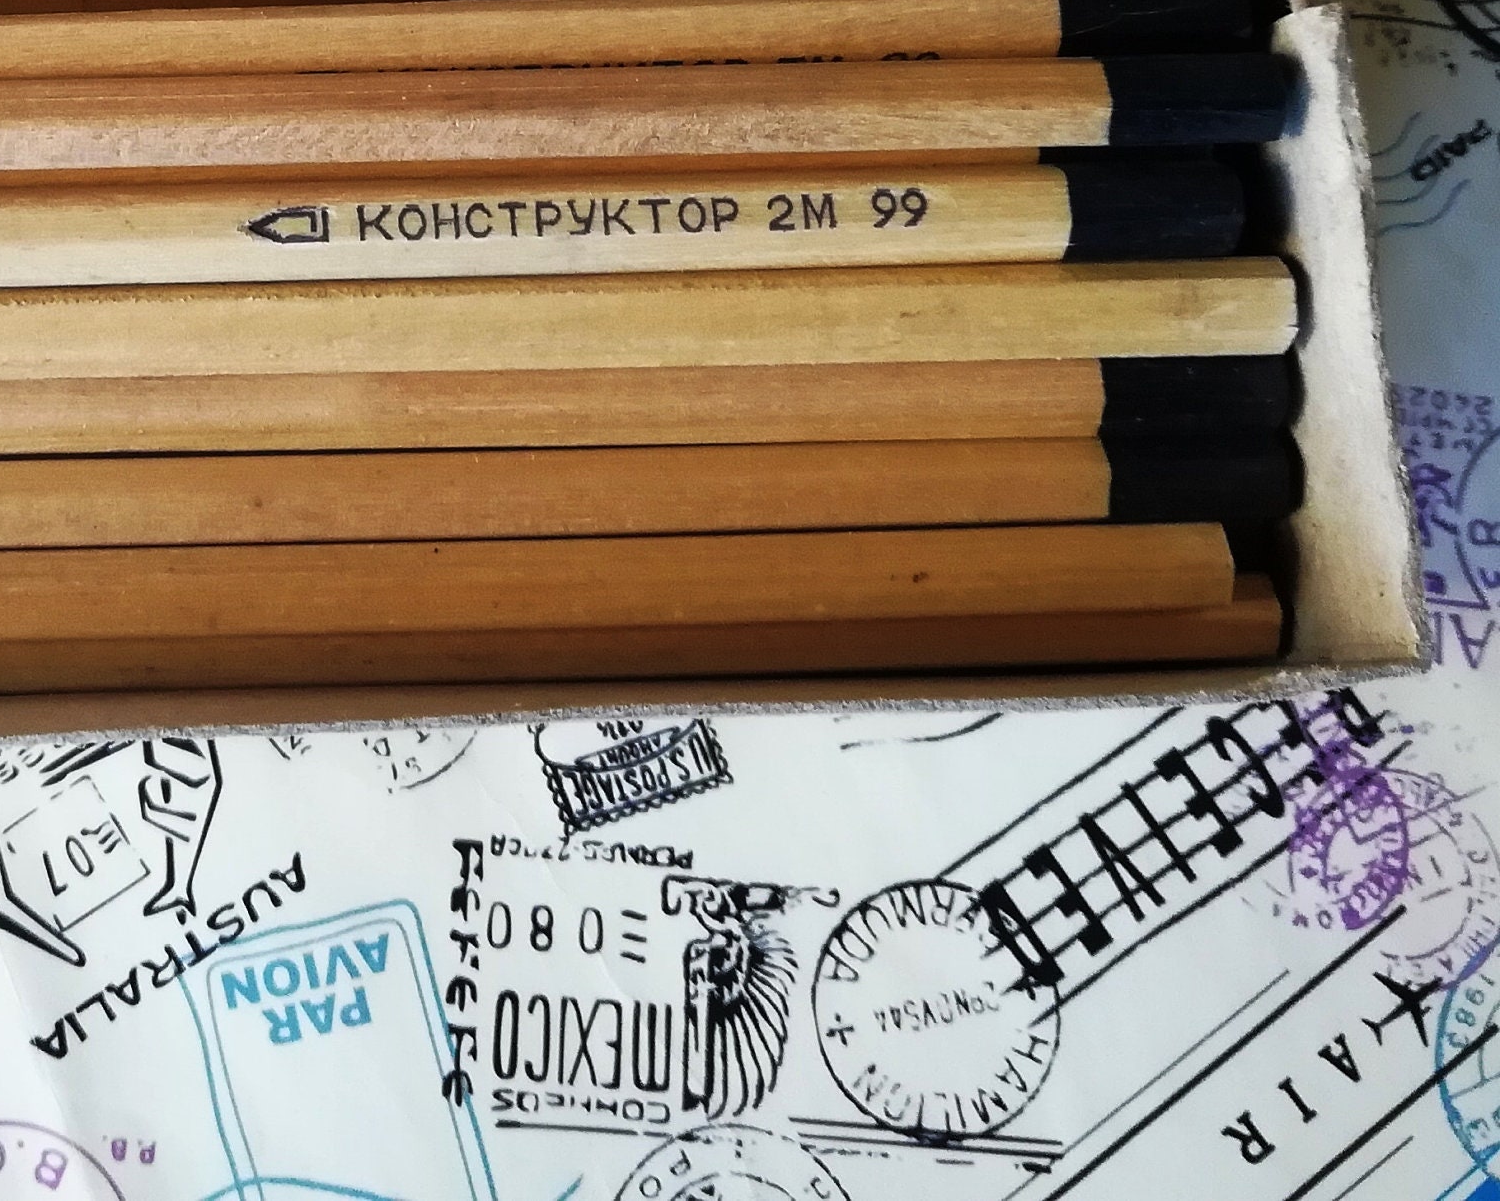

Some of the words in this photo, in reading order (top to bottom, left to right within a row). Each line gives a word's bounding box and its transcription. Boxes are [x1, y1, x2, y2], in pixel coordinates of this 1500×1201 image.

[356, 197, 740, 242] КОНСТРУКТОР
[870, 186, 930, 229] 99
[29, 851, 309, 1059] AUSTRALIA
[223, 932, 390, 1009] AVION
[262, 985, 372, 1046] PAR
[493, 989, 672, 1092] MEXICO
[1222, 1033, 1363, 1165] AIR
